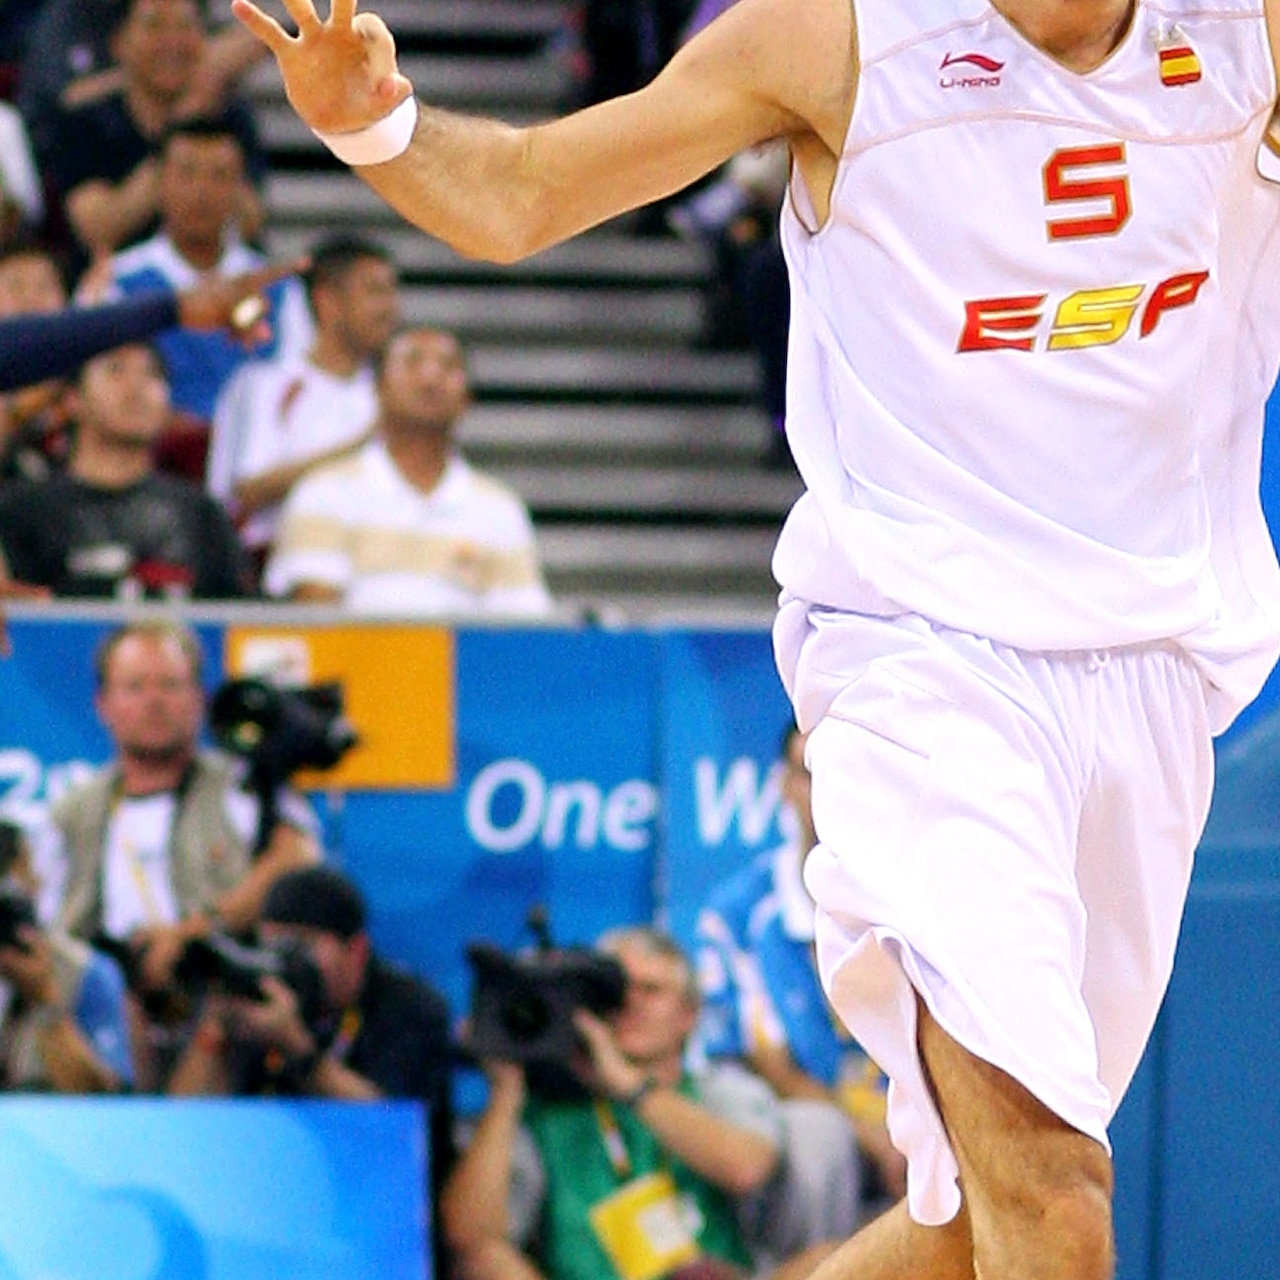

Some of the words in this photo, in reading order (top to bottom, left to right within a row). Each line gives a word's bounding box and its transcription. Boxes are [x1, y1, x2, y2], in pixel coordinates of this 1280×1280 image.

[1041, 139, 1133, 244] 5
[955, 269, 1210, 354] ESP
[466, 757, 656, 851] One
